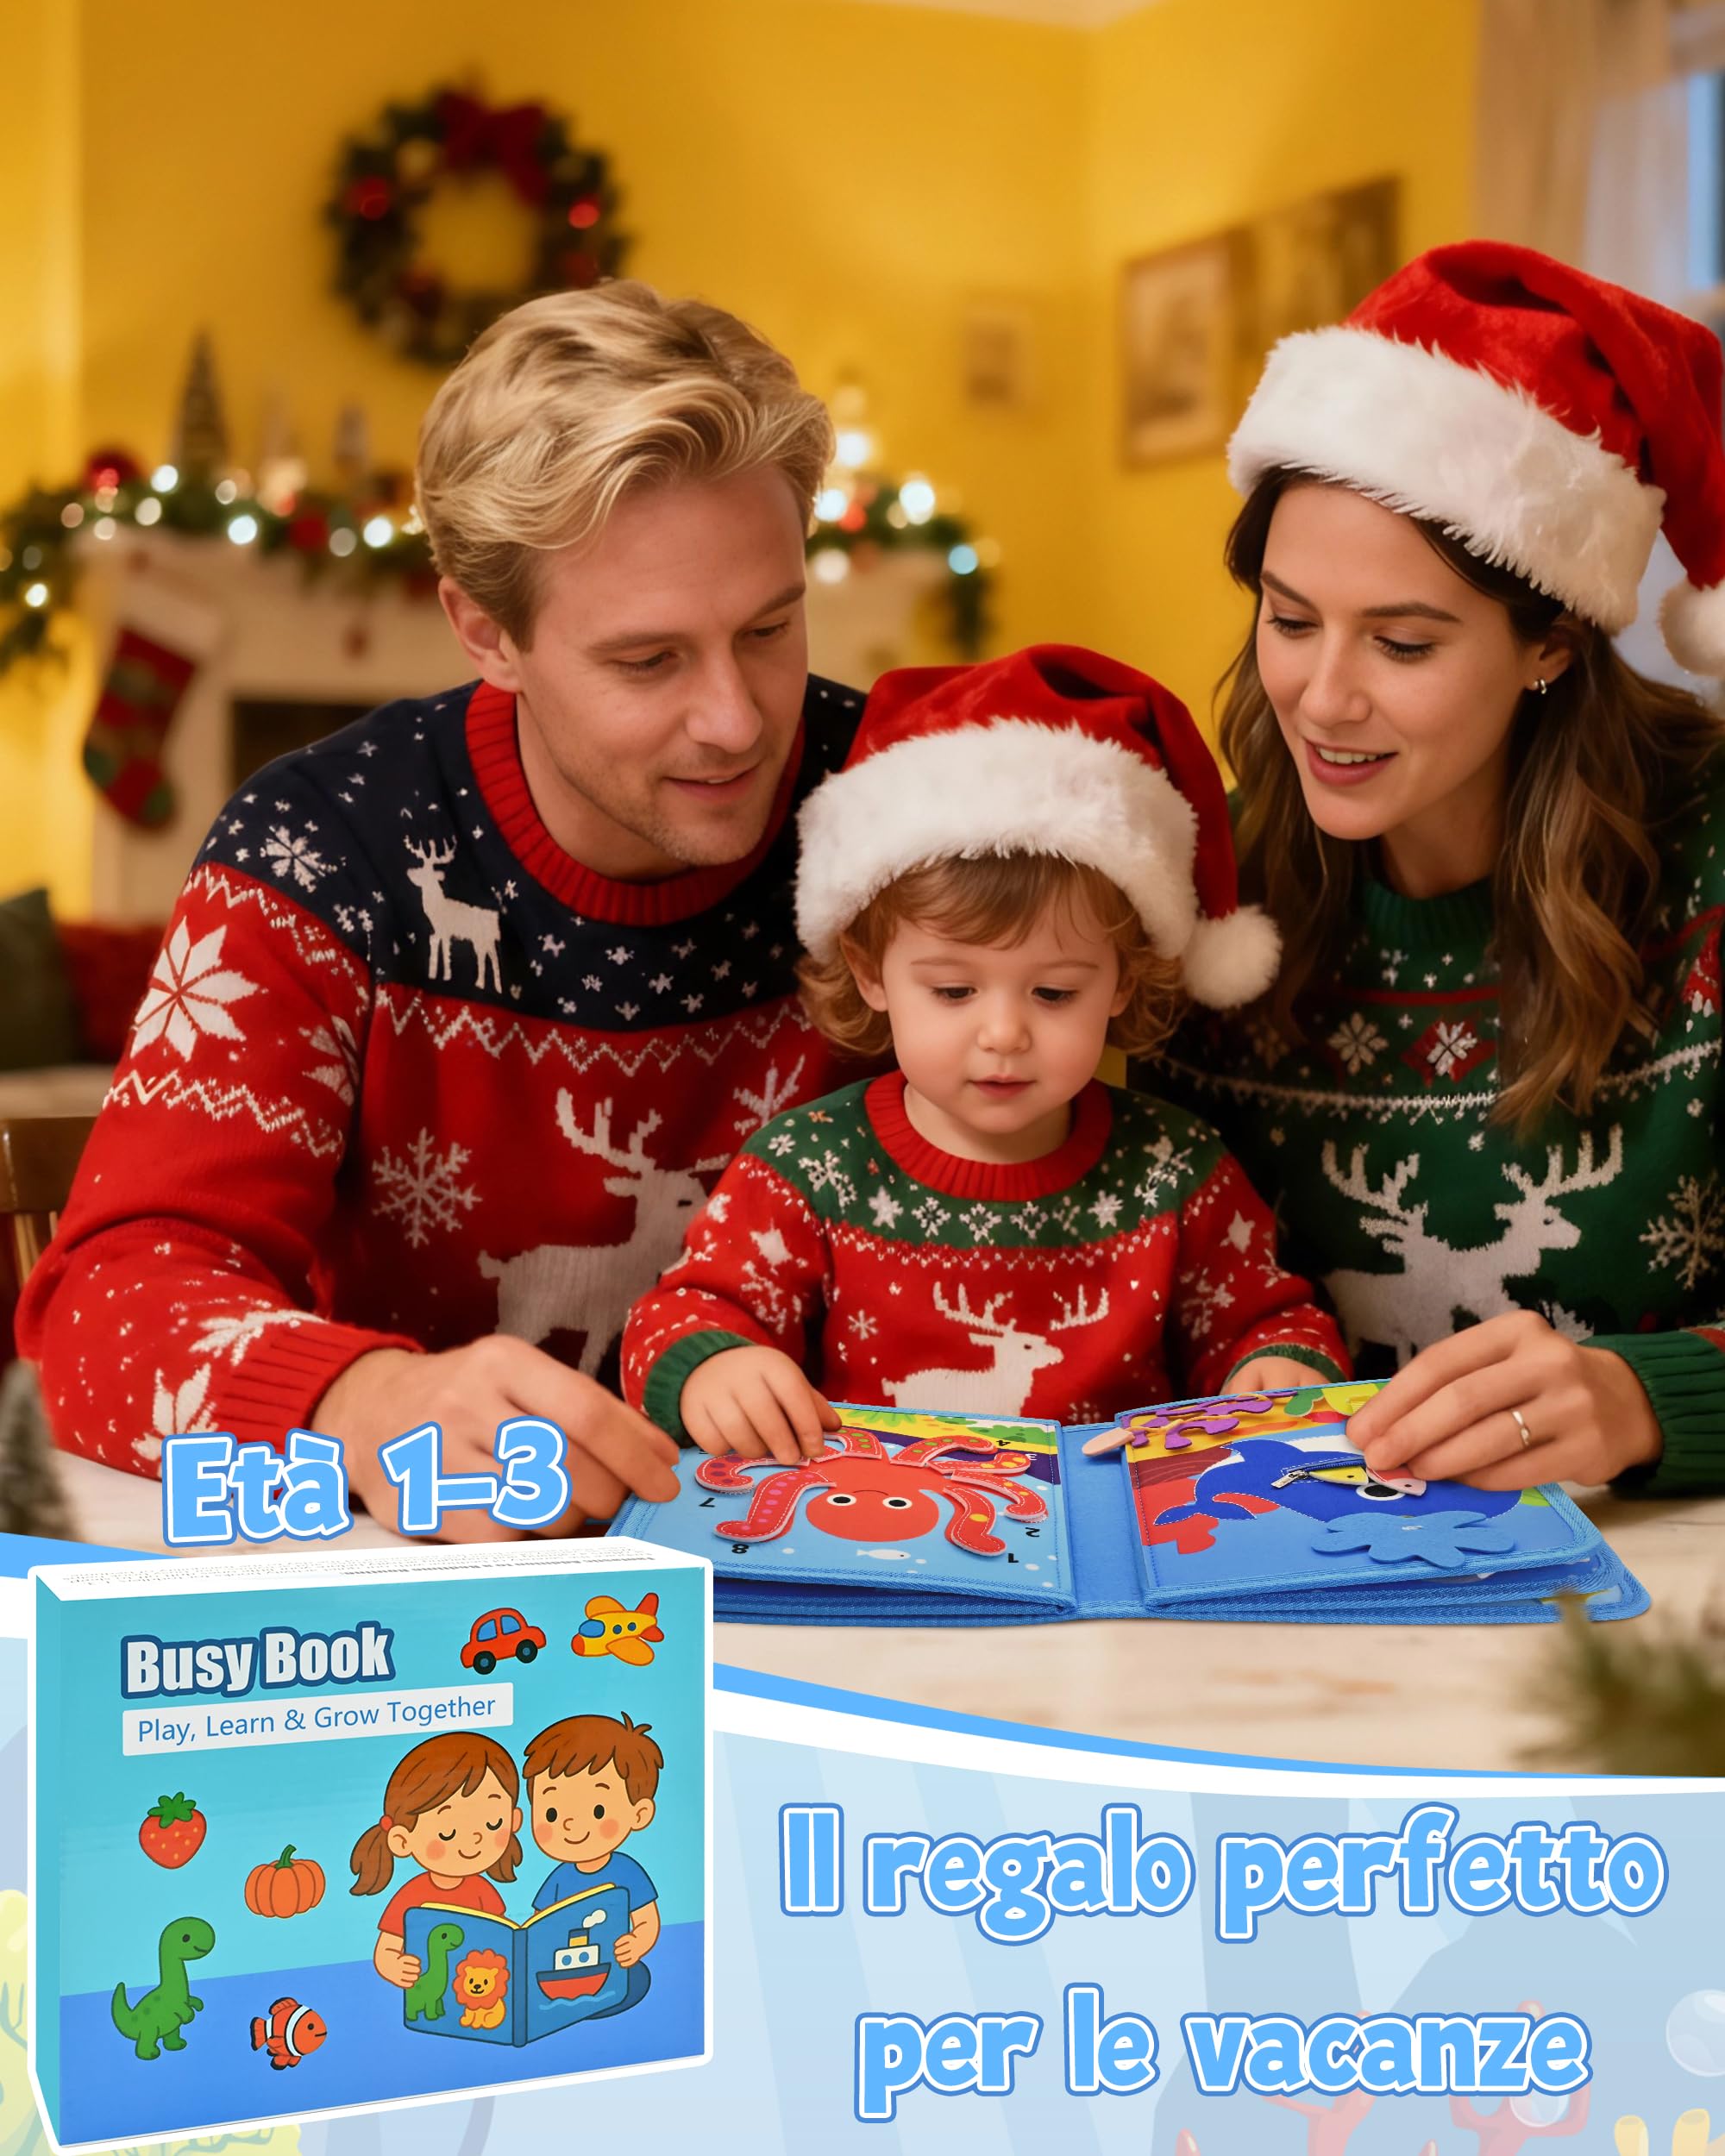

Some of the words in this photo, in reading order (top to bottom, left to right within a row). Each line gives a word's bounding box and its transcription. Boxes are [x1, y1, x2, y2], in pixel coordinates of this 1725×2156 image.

[699, 1497, 715, 1507] 7
[1025, 1526, 1040, 1538] 2
[731, 1544, 750, 1554] 8
[1007, 1553, 1019, 1563] 1
[127, 1640, 254, 1693] Busy
[265, 1626, 391, 1683] Book
[138, 1719, 196, 1745] Play,
[206, 1714, 274, 1737] Learn
[284, 1709, 305, 1730] &
[314, 1707, 380, 1728] Grow
[387, 1696, 496, 1727] Together
